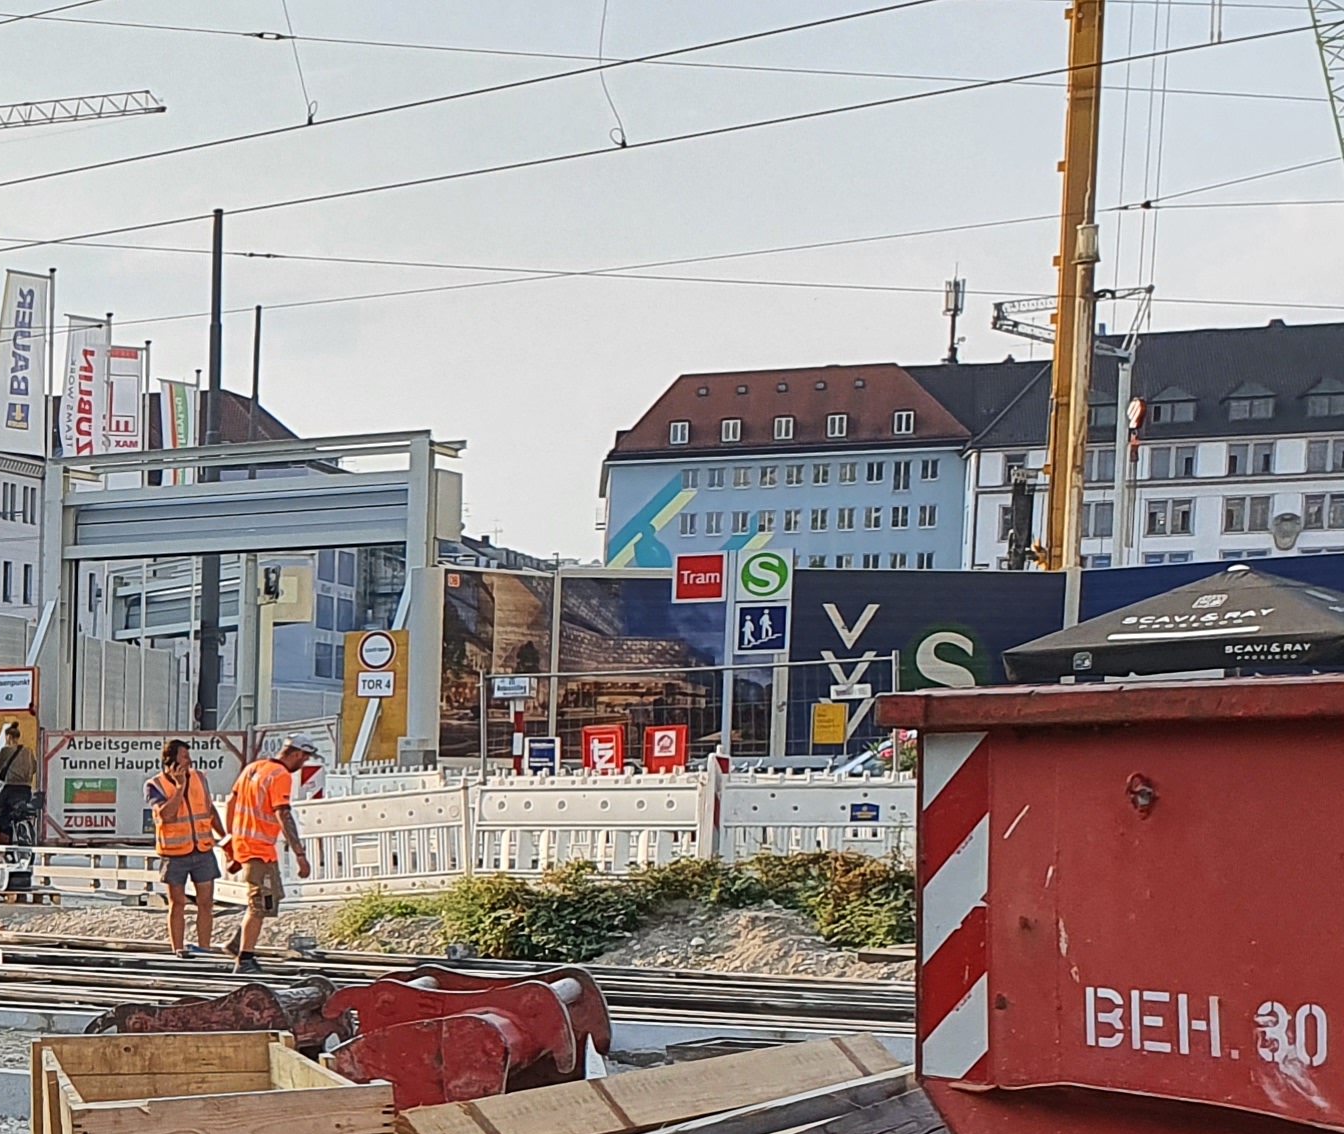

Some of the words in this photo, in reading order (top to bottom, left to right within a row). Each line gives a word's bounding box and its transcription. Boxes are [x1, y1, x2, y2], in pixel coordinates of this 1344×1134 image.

[680, 569, 721, 586] Tram
[747, 556, 783, 594] S
[1121, 613, 1197, 626] SCAVI
[1200, 611, 1220, 622] &
[1223, 607, 1276, 620] RAY
[1224, 643, 1268, 655] SCAVI
[1269, 642, 1282, 653] &
[1283, 642, 1312, 652] RAY
[361, 679, 383, 691] TOR
[385, 679, 392, 690] 4
[67, 736, 221, 753] Arbeitsgemeihaft
[60, 756, 111, 770] Tunnel
[115, 755, 224, 773] Hauptnhof
[63, 815, 116, 828] ZÜBLIN
[1084, 985, 1240, 1061] BEH.
